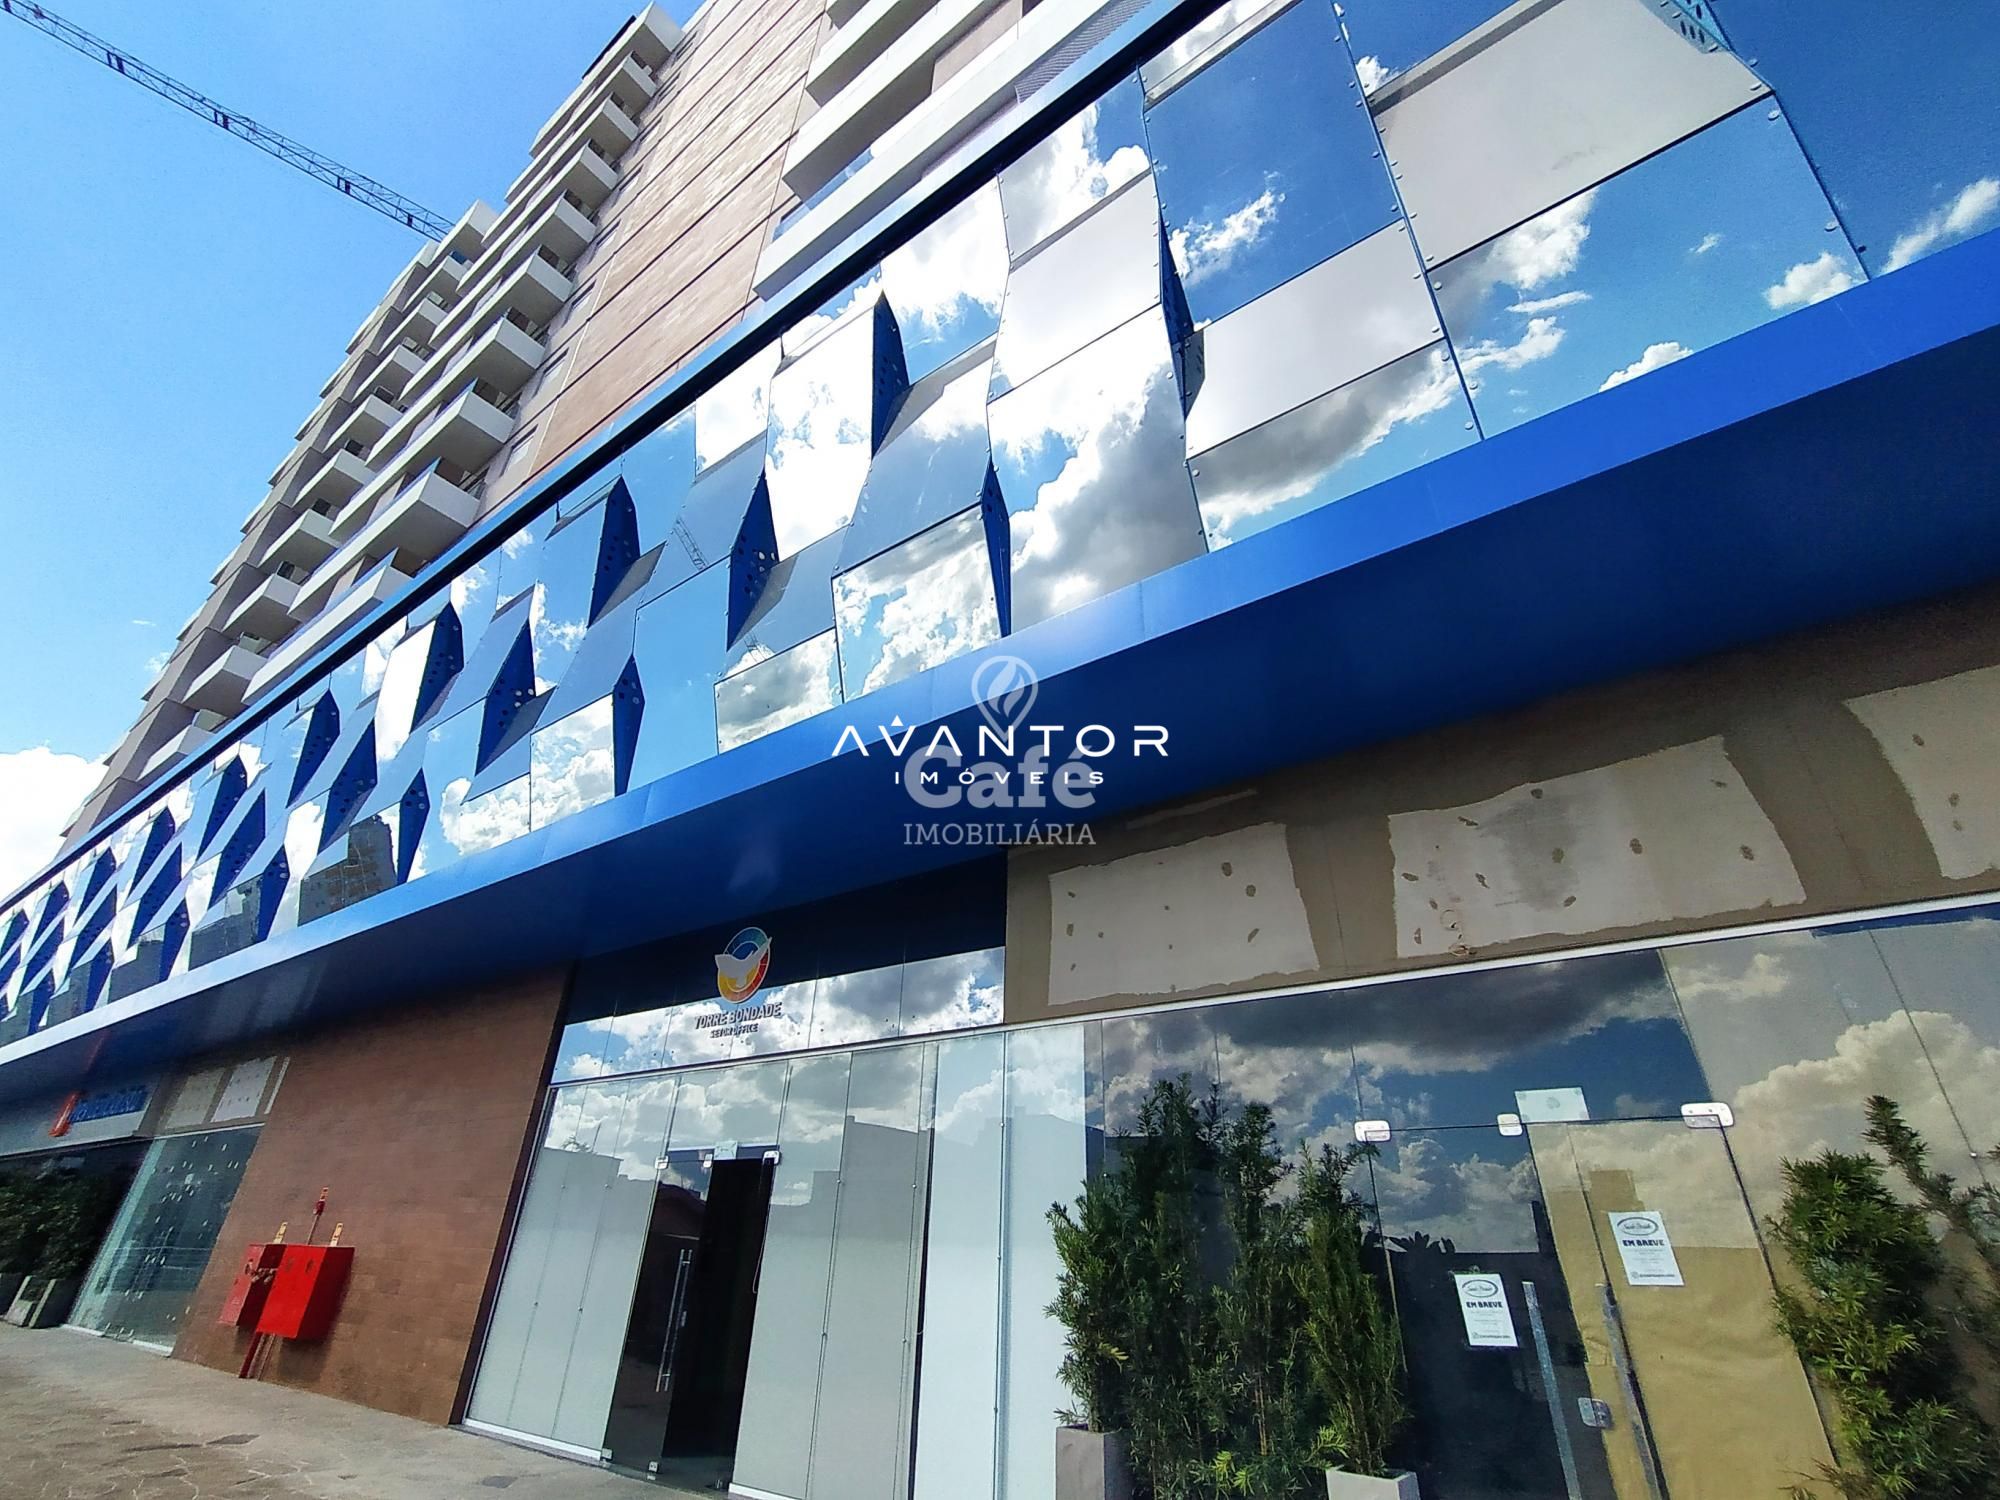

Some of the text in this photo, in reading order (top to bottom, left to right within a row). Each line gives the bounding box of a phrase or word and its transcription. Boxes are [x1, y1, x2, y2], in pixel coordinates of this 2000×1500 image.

[694, 1002, 783, 1030] TORRE BONDADE
[1622, 1239, 1665, 1247] EM BREVE
